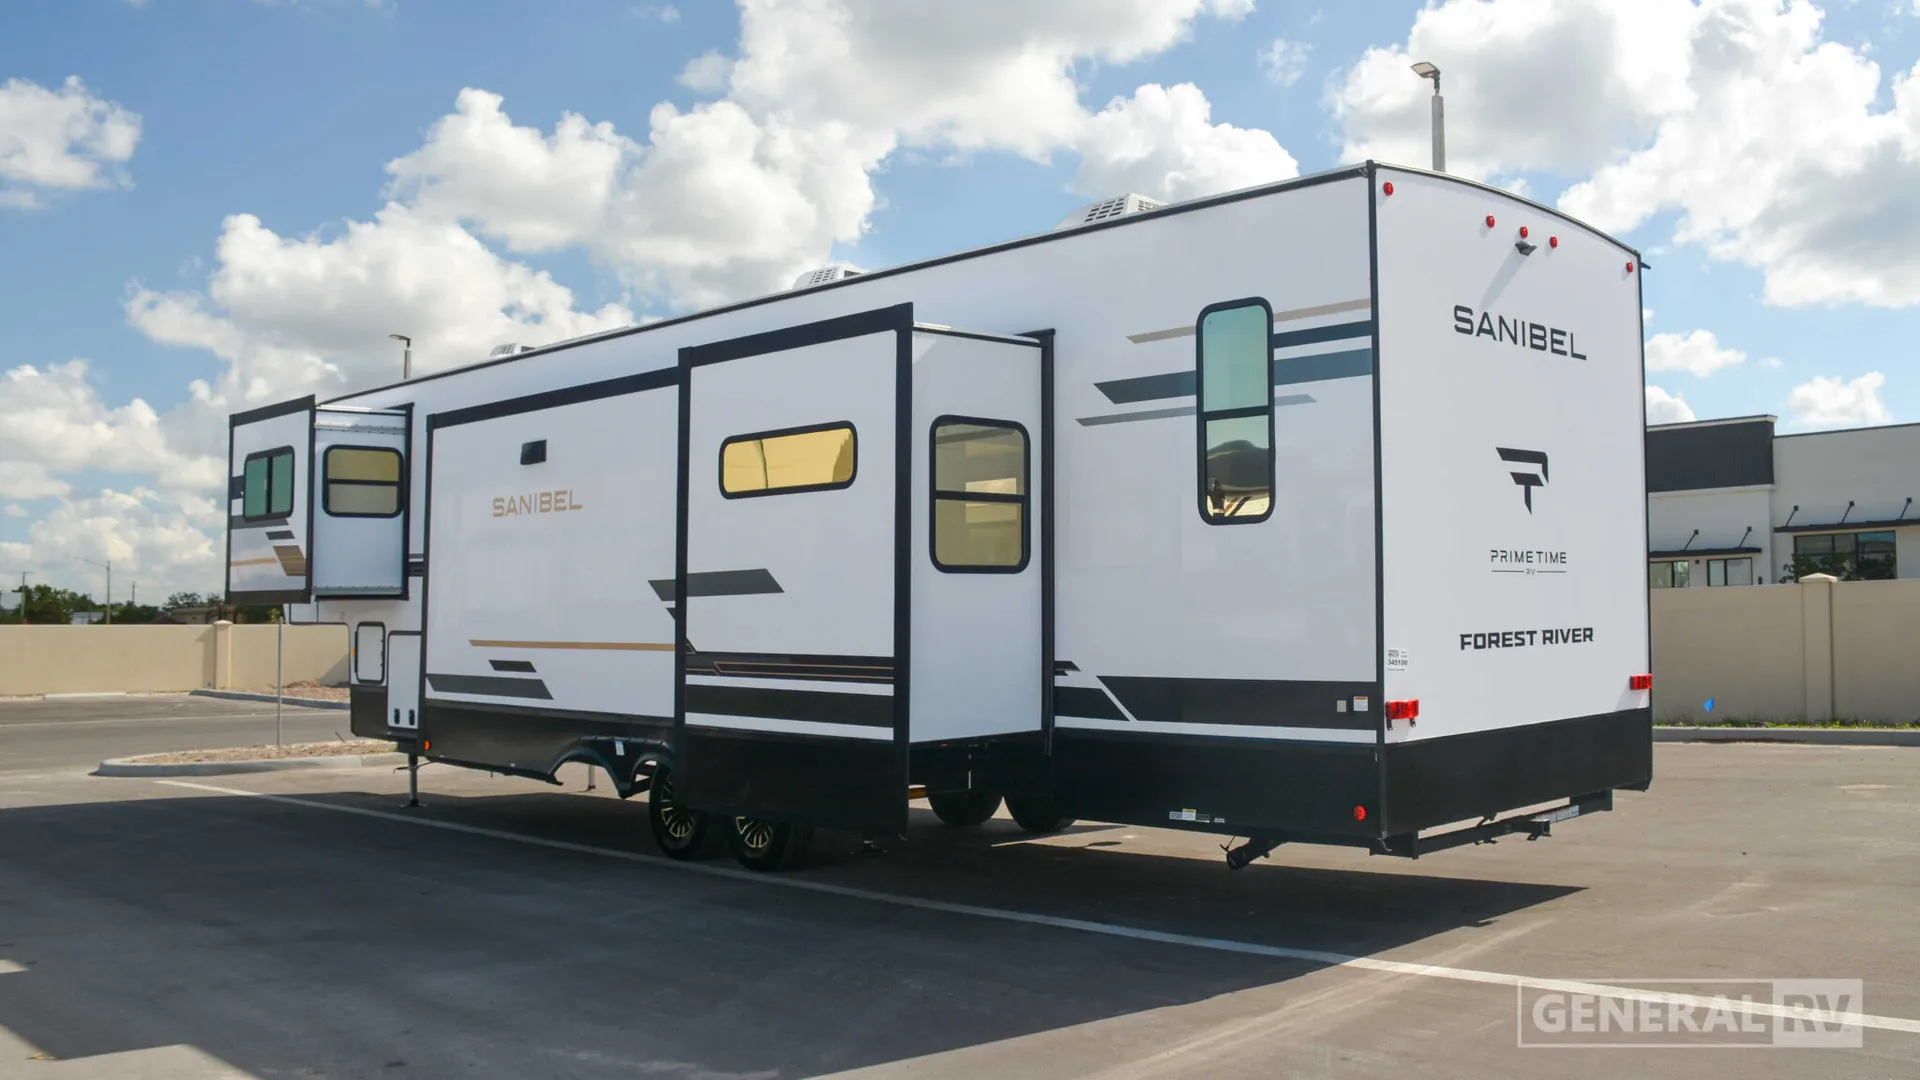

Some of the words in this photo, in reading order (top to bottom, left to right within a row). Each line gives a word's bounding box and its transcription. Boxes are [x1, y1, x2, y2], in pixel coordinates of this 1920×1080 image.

[1454, 305, 1587, 360] SANIBEL
[492, 490, 583, 518] SANIBEL
[1525, 568, 1535, 576] RV
[1460, 631, 1537, 651] FOREST
[1542, 627, 1594, 645] RIVER
